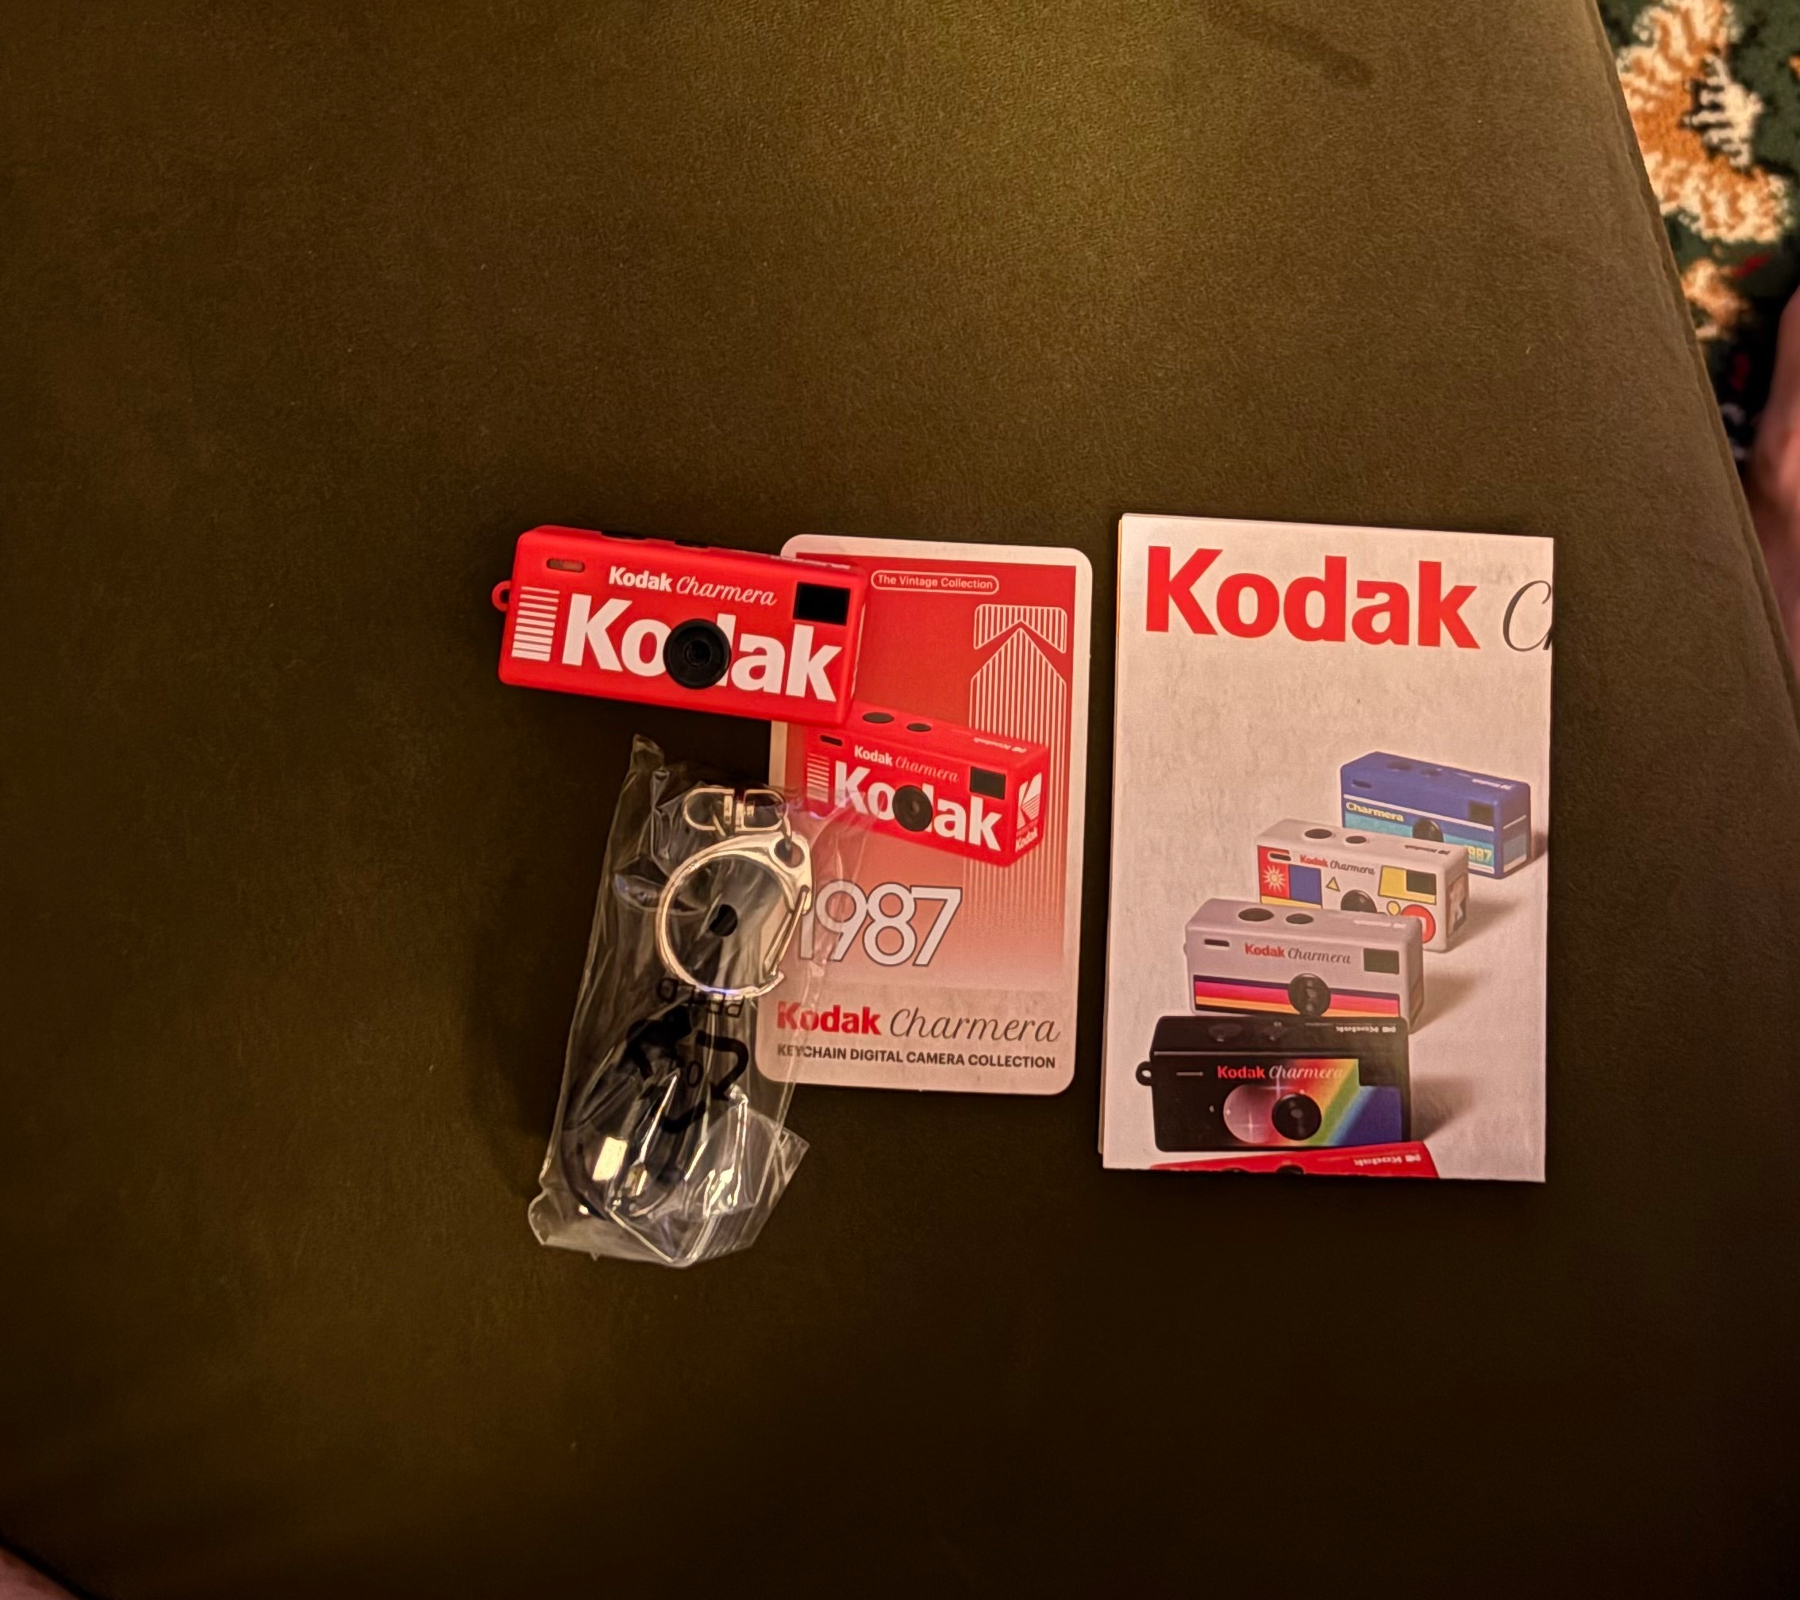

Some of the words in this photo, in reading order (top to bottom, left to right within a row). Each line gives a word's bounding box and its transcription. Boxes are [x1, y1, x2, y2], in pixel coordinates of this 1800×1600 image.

[608, 566, 673, 593] Kodak
[676, 575, 778, 607] Charmera
[877, 573, 897, 586] The
[899, 575, 938, 589] Vintage
[941, 577, 993, 590] Collection
[1145, 545, 1480, 649] Kodak
[1502, 580, 1552, 652] C
[854, 744, 893, 767] Kodak
[894, 755, 960, 783] Charmera
[1345, 801, 1405, 823] Charmera
[1299, 854, 1329, 868] Kodak
[1329, 859, 1376, 876] Charmera
[799, 879, 963, 967] 1987
[1244, 942, 1285, 959] Kodak
[1287, 947, 1352, 965] Charmera
[776, 1000, 882, 1036] Kodak
[889, 1006, 1061, 1043] Charmera
[777, 1043, 847, 1061] KEYCHAIN
[850, 1048, 904, 1064] DIGITAL
[906, 1051, 965, 1067] CAMERA
[967, 1054, 1056, 1069] COLLECTION
[1216, 1065, 1265, 1080] Kodak
[1268, 1064, 1346, 1081] Charmera
